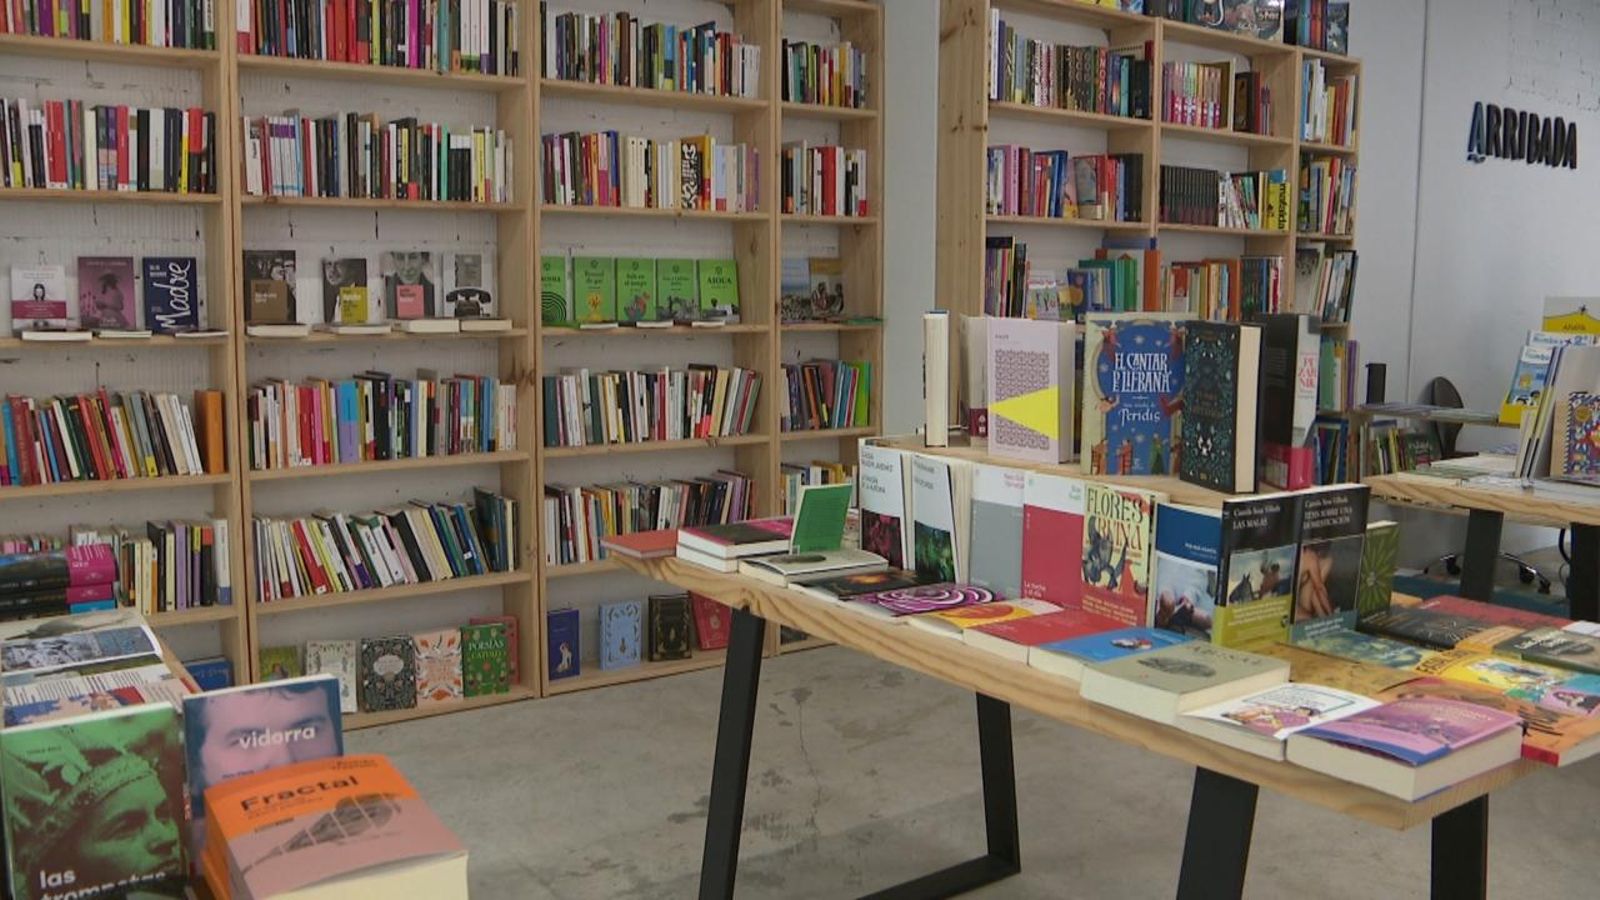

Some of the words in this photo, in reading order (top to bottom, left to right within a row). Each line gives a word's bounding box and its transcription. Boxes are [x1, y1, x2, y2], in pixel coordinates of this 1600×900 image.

[1467, 101, 1577, 169] ARRIBADA
[1278, 183, 1287, 229] mafalda
[153, 260, 191, 329] Madre
[1114, 352, 1126, 370] EL
[1126, 352, 1168, 372] CANTAR
[1120, 408, 1160, 427] Peridis
[1087, 487, 1143, 524] FLORES
[240, 727, 315, 749] vidorra
[240, 775, 359, 811] Fractal
[39, 869, 76, 889] las
